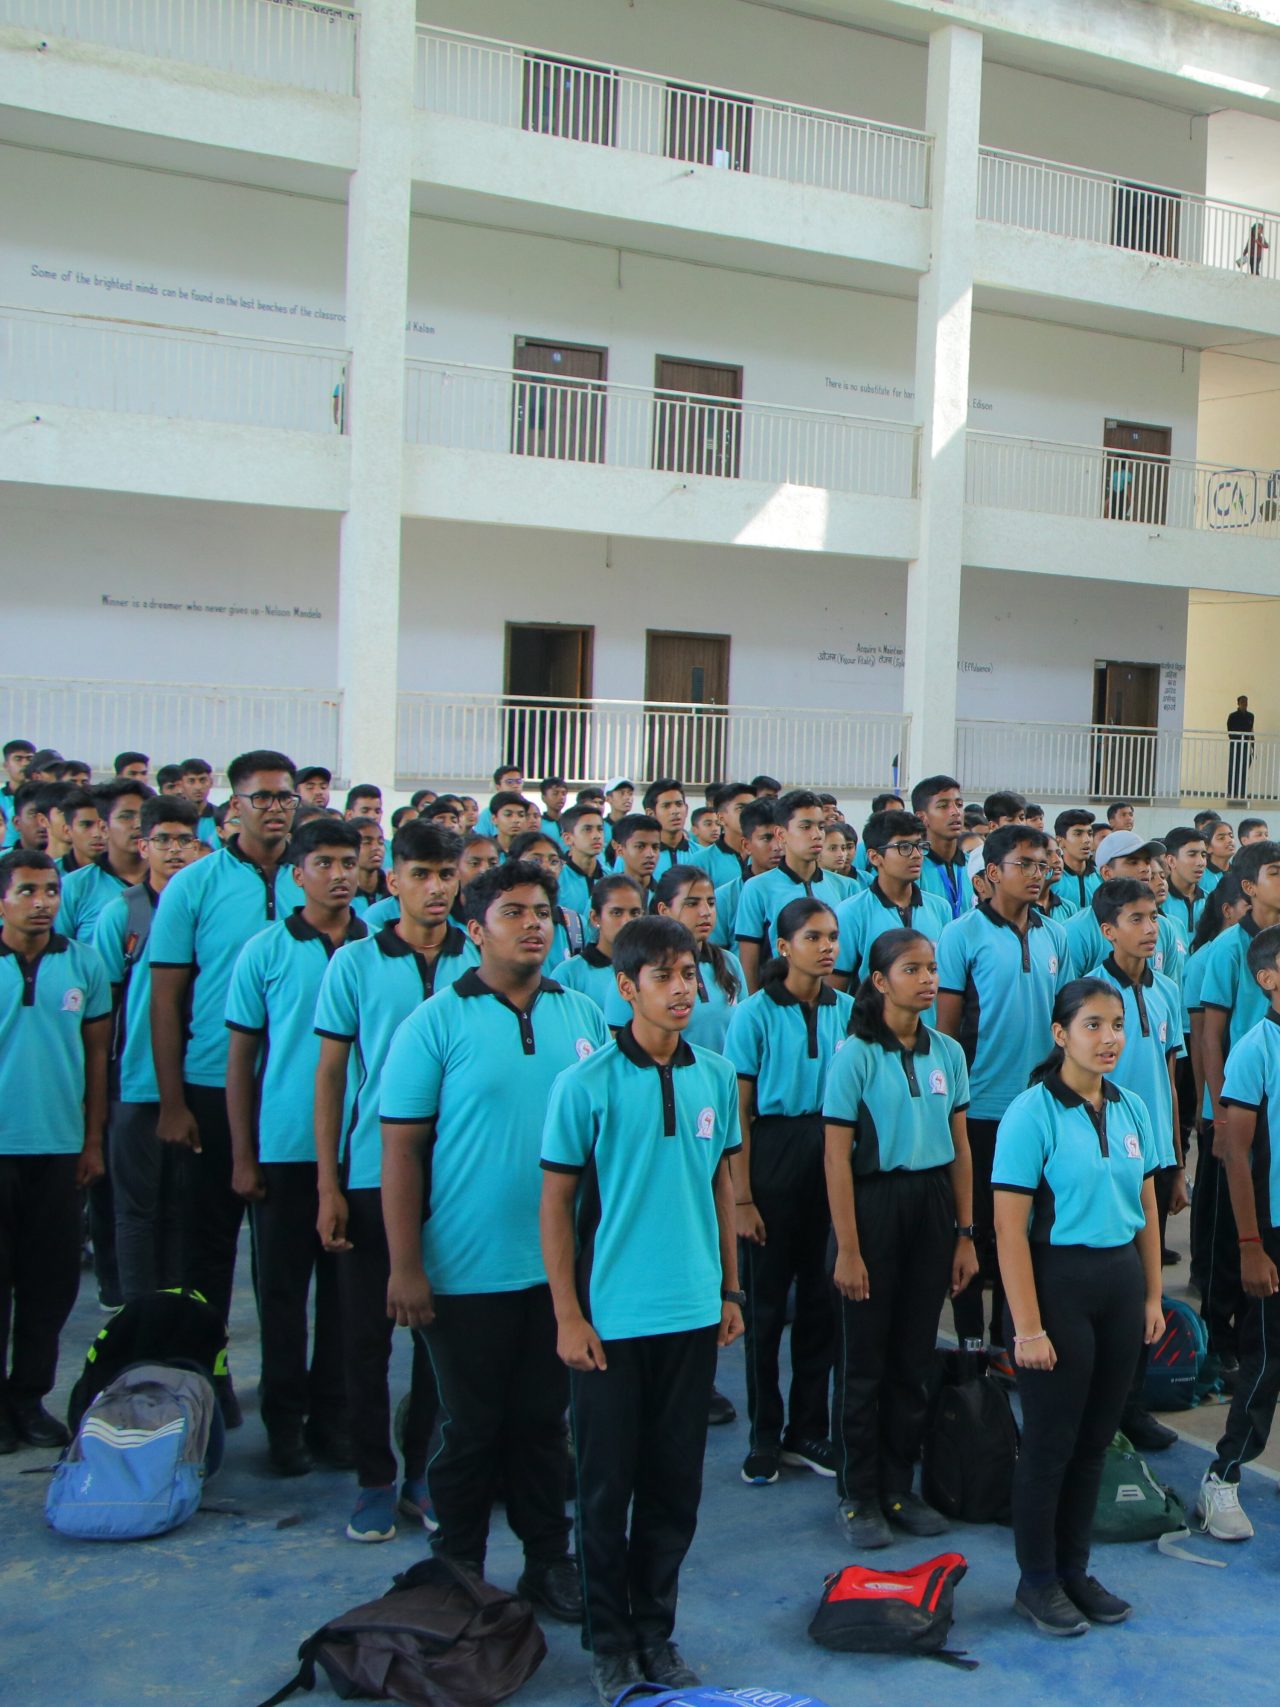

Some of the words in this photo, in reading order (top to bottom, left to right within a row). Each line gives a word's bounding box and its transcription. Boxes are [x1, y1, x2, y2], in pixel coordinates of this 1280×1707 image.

[31, 264, 57, 279] Some
[61, 270, 73, 281] of
[76, 271, 91, 285] the
[94, 274, 133, 291] brightest
[161, 289, 177, 298] can
[178, 287, 190, 299] be
[191, 289, 213, 303] found
[226, 294, 239, 306] the
[257, 299, 288, 314] benches
[289, 304, 299, 315] of
[300, 305, 312, 318] the
[825, 376, 842, 390] There
[892, 387, 902, 398] for
[973, 398, 993, 411] Edison
[205, 604, 226, 613] never
